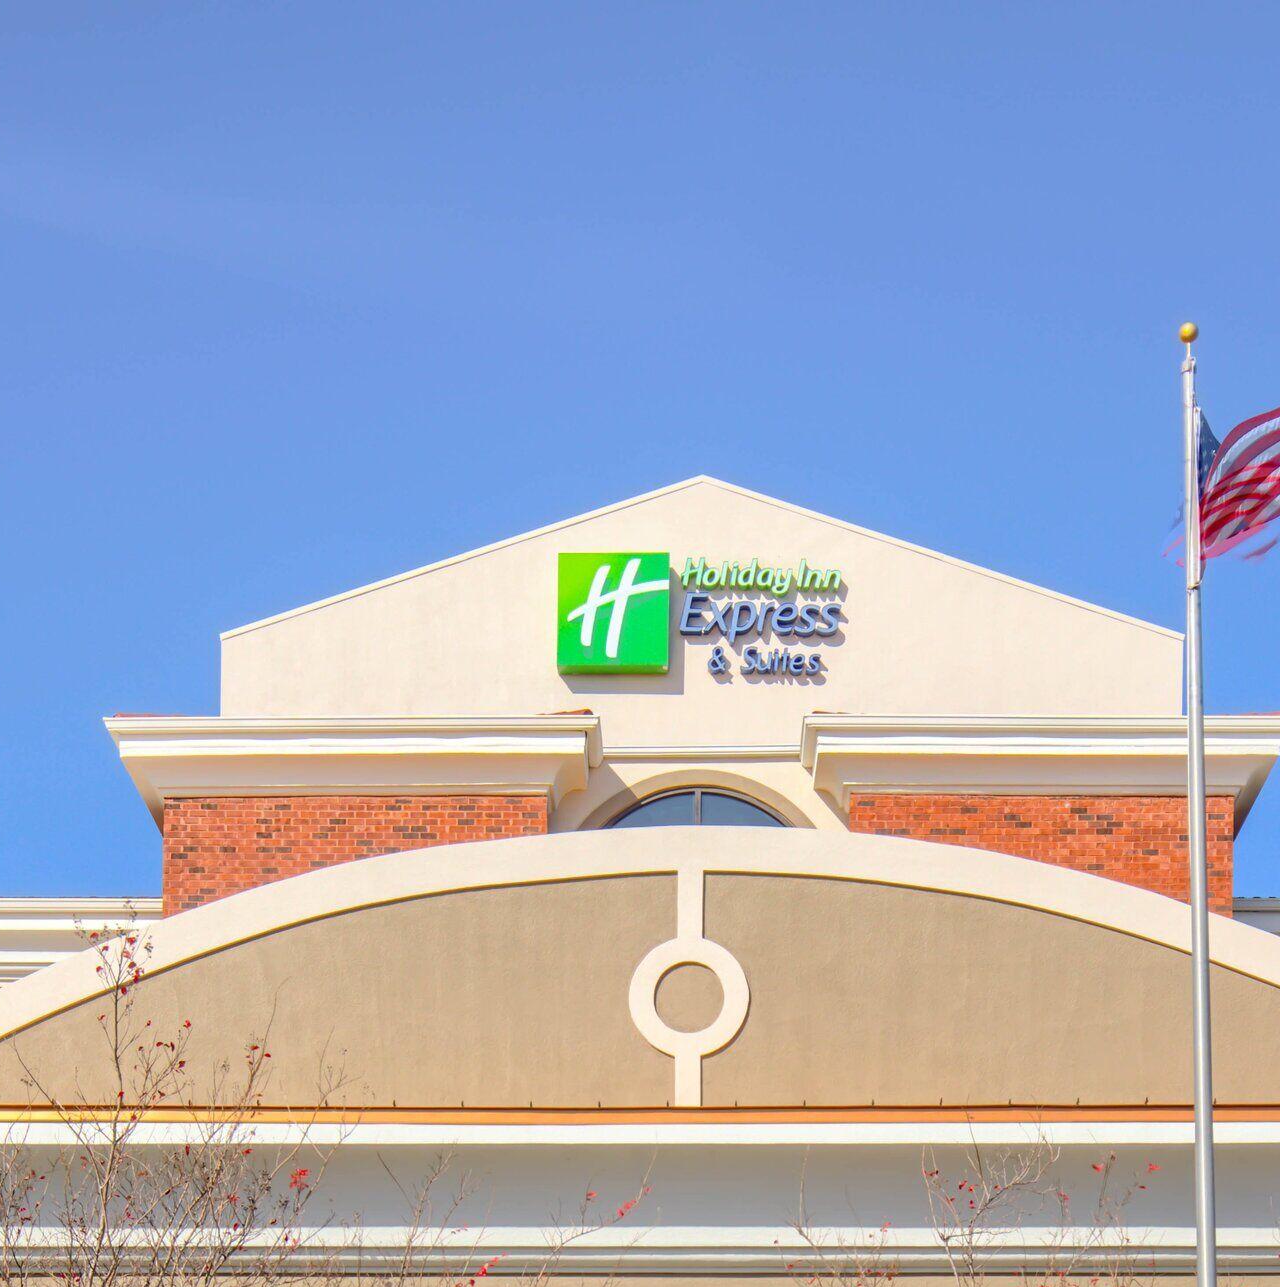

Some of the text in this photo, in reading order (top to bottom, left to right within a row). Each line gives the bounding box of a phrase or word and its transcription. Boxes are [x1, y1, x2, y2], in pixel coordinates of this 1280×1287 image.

[681, 557, 842, 597] Holiday Inn
[680, 592, 842, 646] Express
[707, 646, 822, 676] & Suites
